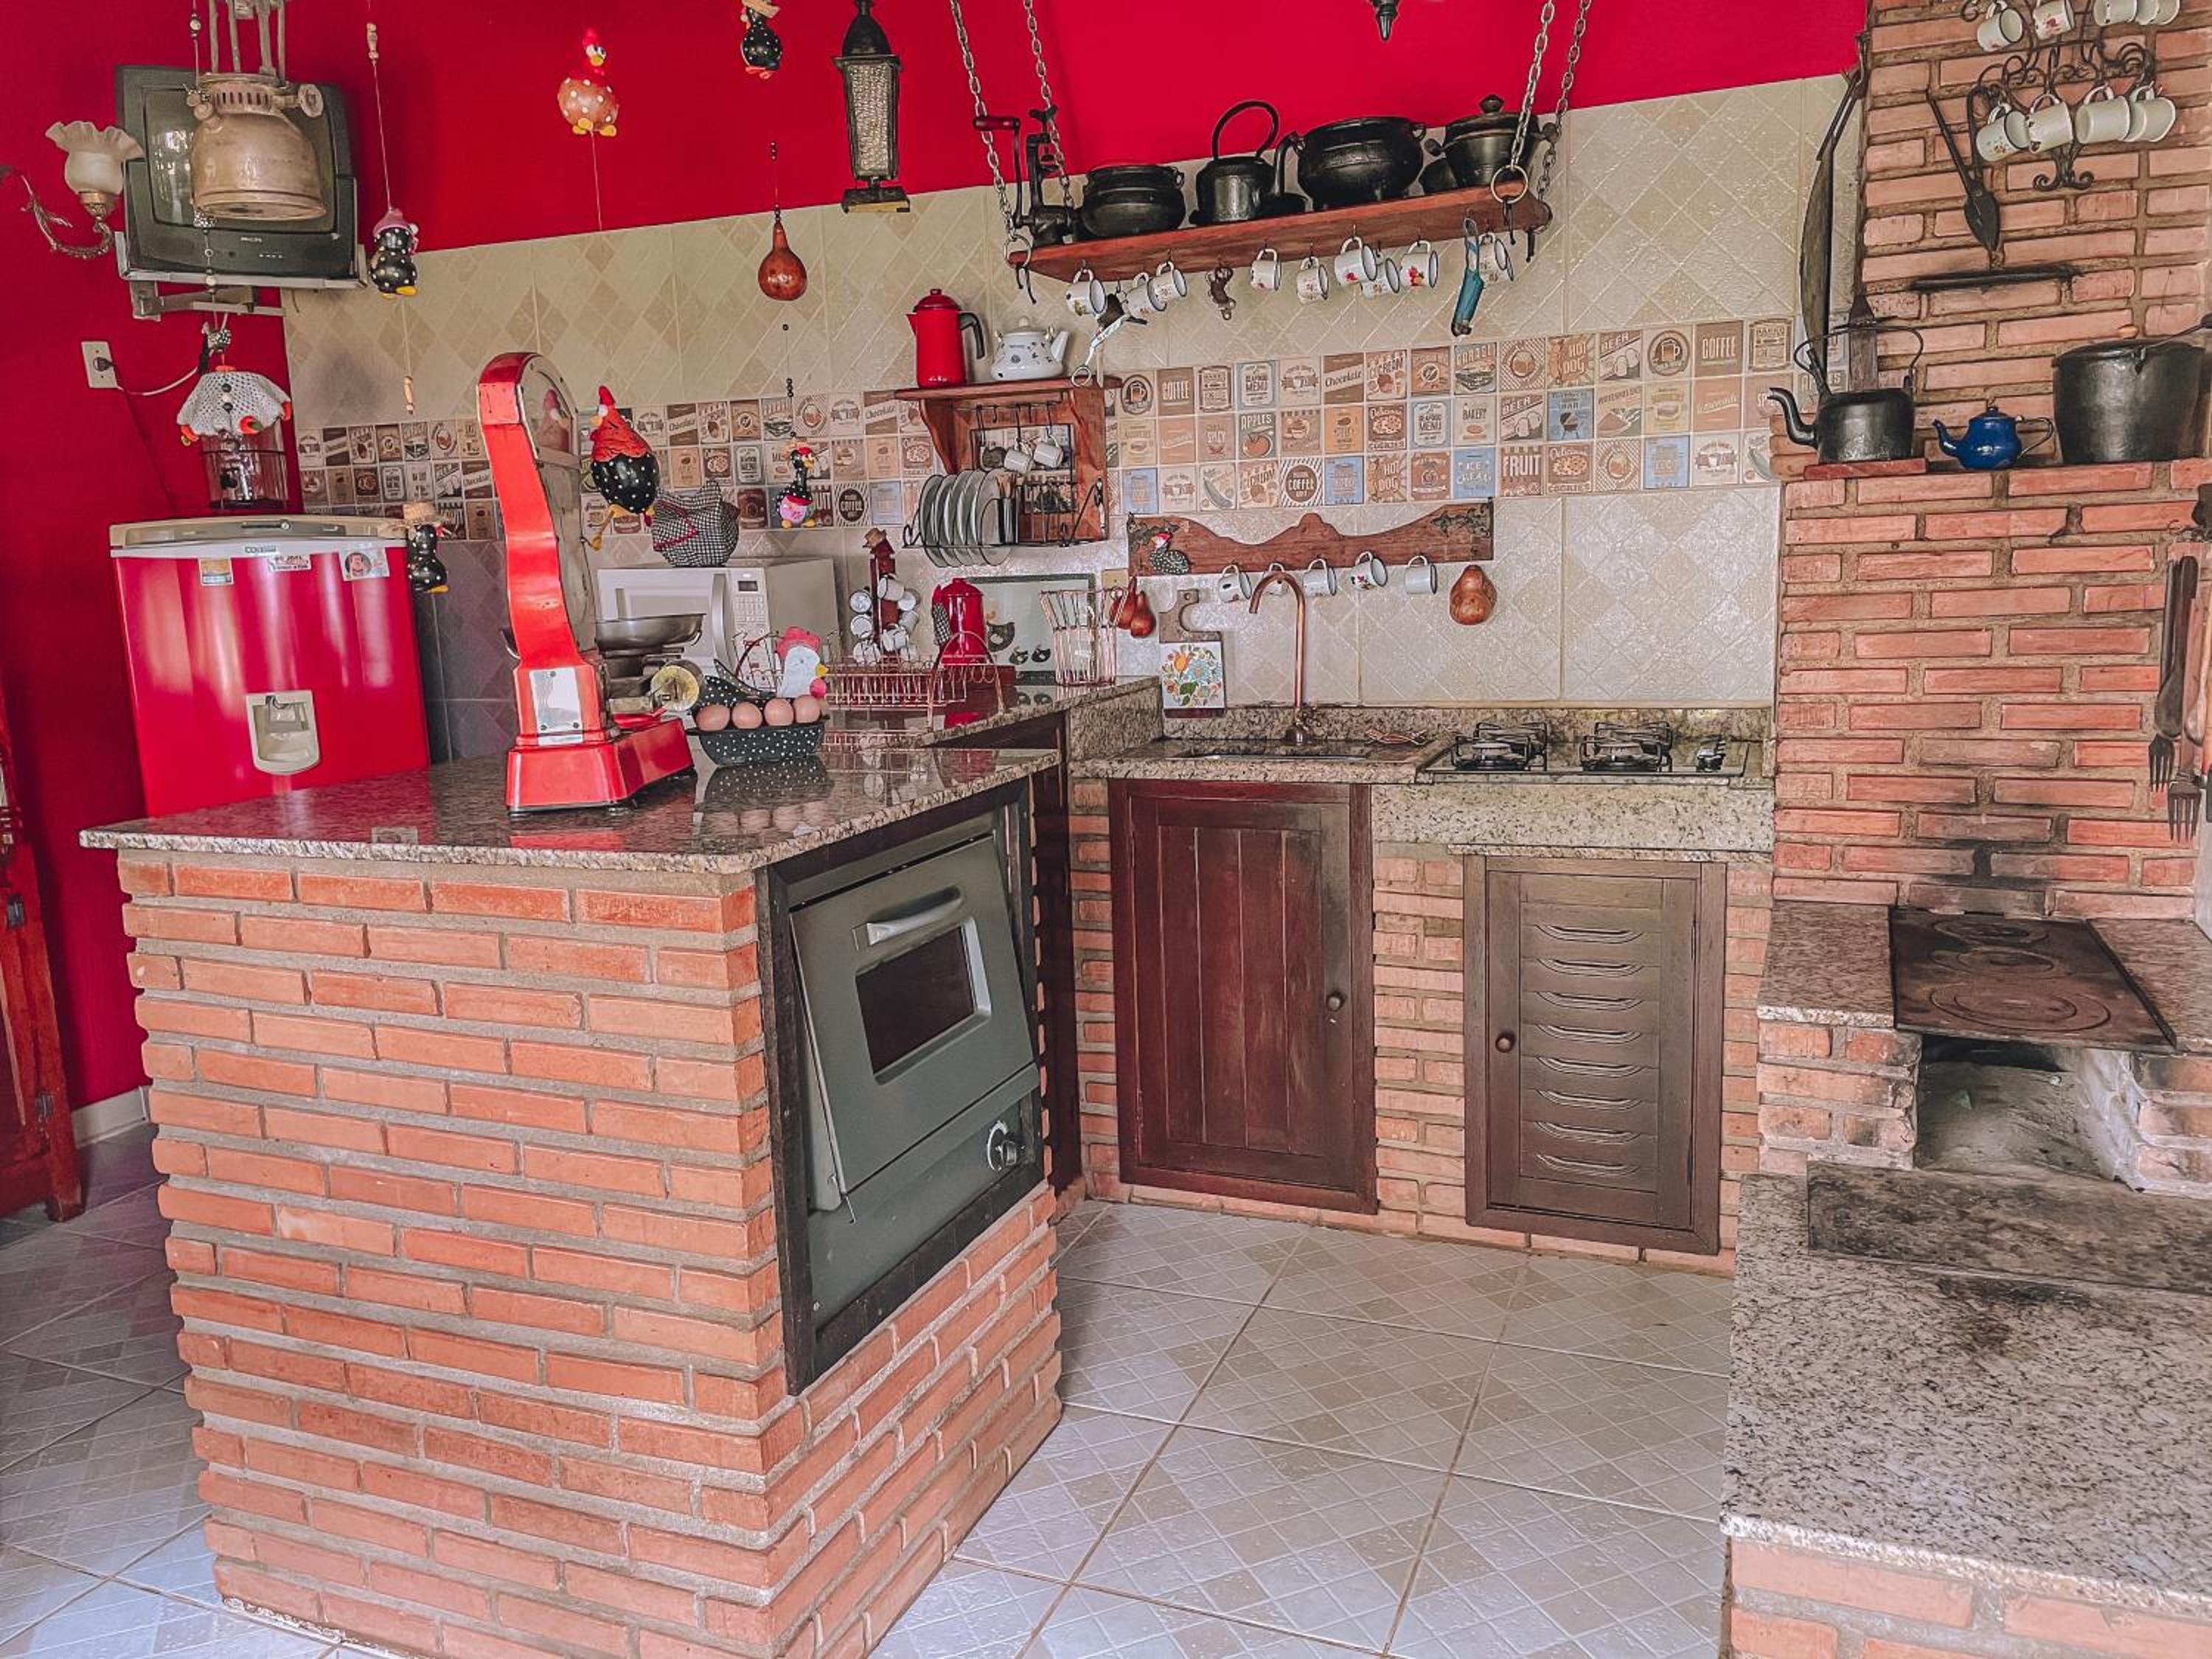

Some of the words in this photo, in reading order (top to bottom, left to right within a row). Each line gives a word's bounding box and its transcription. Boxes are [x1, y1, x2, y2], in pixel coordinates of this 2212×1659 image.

[1568, 341, 1586, 357] HOT
[1702, 336, 1736, 360] COFFEE
[1563, 358, 1585, 375] DOG
[1325, 369, 1363, 387] Chocolate
[1162, 380, 1189, 400] COFFEE
[1241, 414, 1272, 431] APPLES
[1463, 408, 1486, 420] BAKERY
[1383, 462, 1399, 475] HOT
[1466, 462, 1482, 470] ICE
[1503, 455, 1540, 477] FRUIT
[1289, 479, 1314, 490] COFFEE
